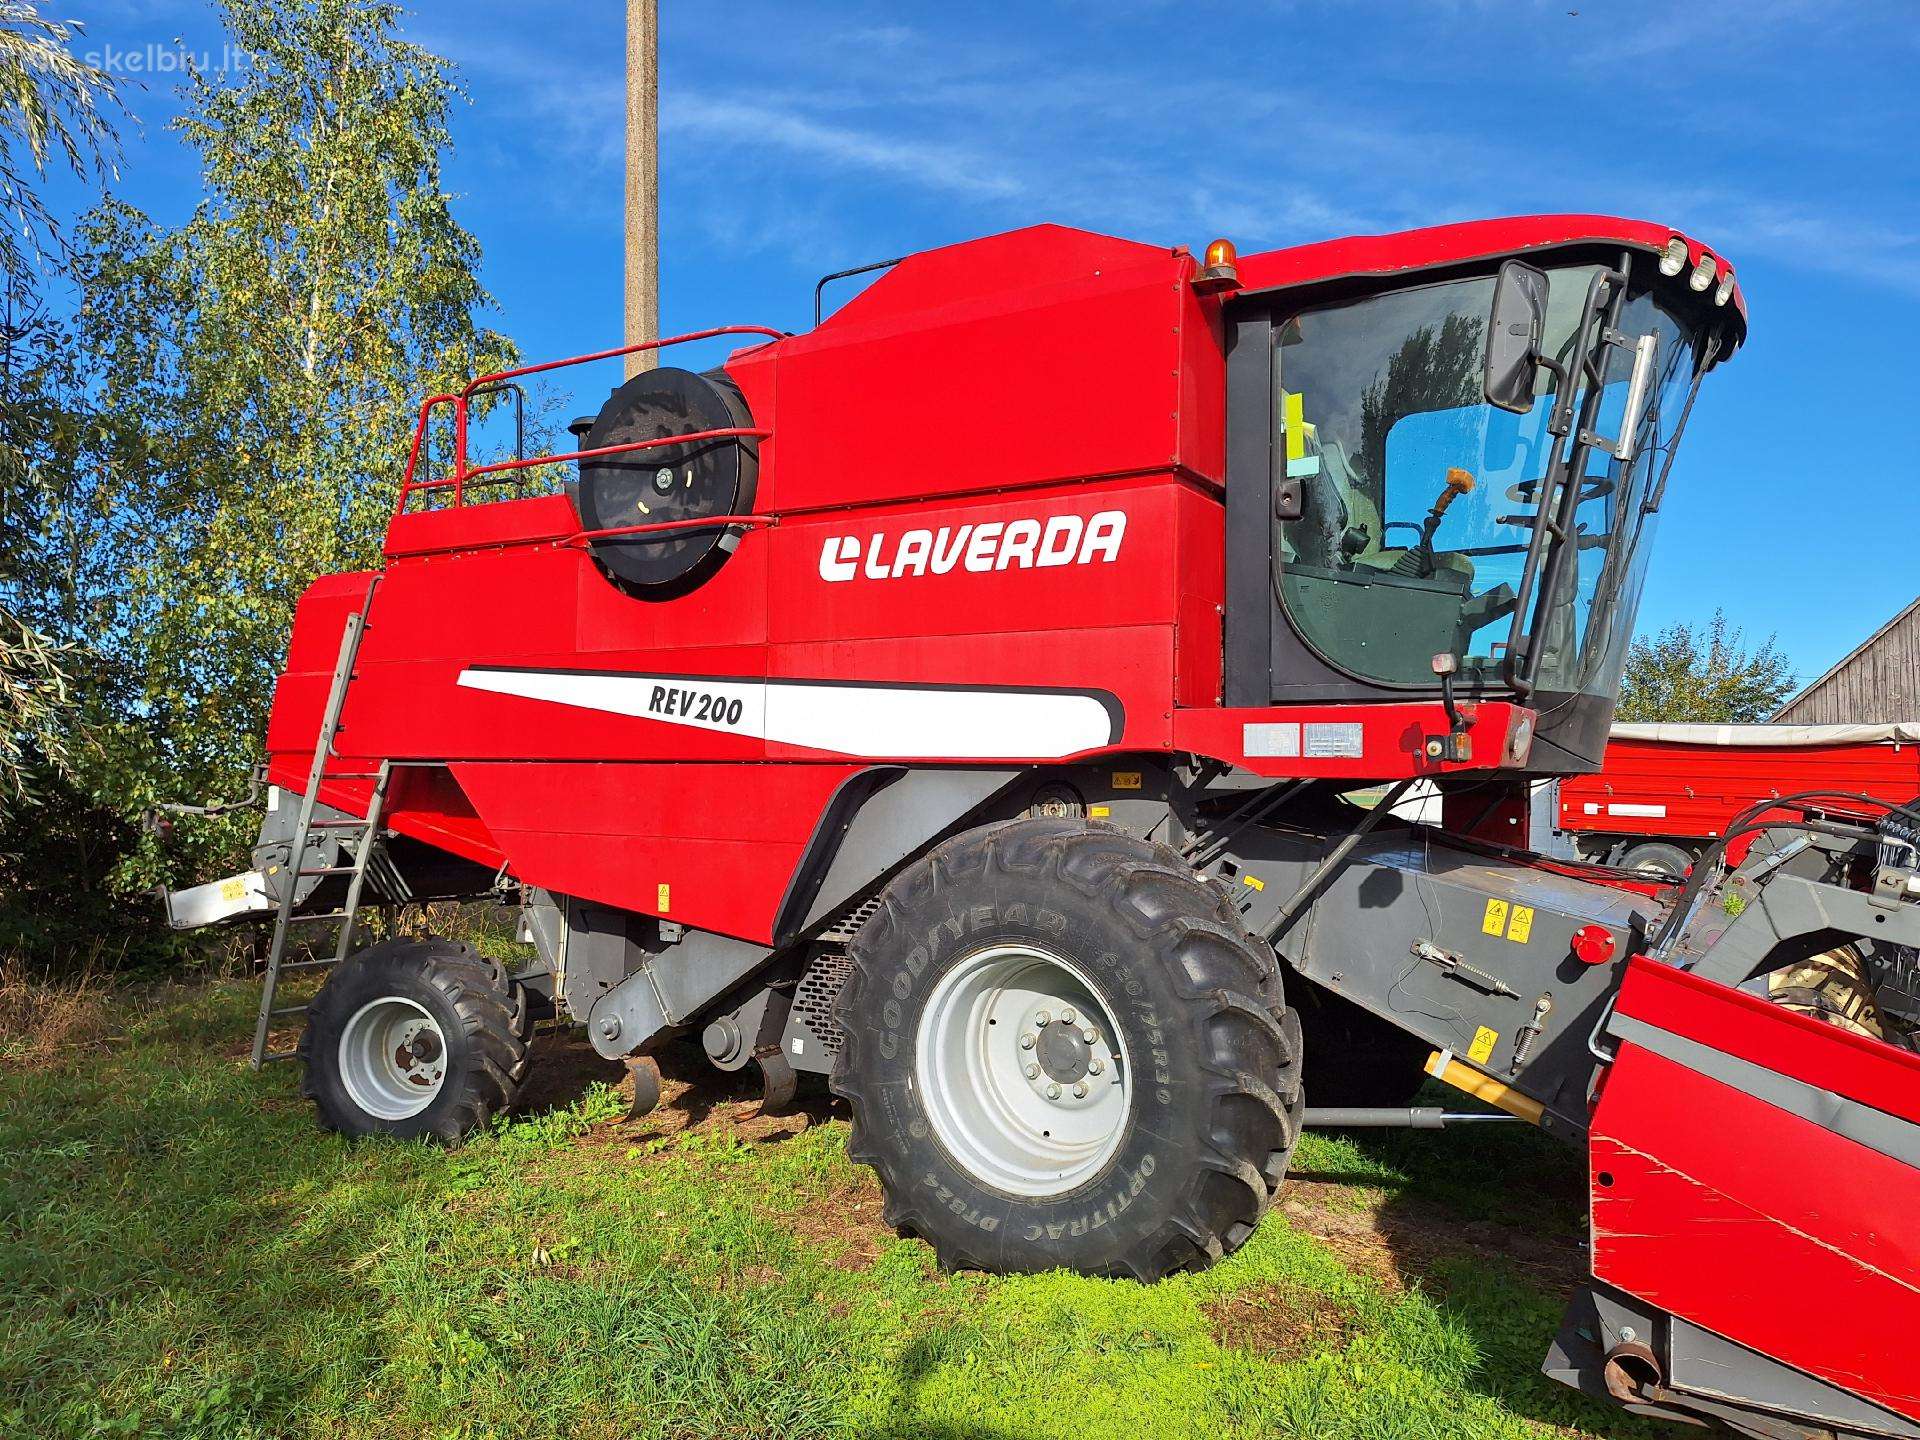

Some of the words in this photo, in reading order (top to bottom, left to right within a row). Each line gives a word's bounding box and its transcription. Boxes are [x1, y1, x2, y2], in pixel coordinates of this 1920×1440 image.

[864, 509, 1127, 580] LAVERDA
[648, 685, 743, 725] REV200
[879, 903, 1067, 1060] GOODYEAR
[922, 1171, 1001, 1232] DT824
[1023, 1154, 1156, 1241] OPTITRAC
